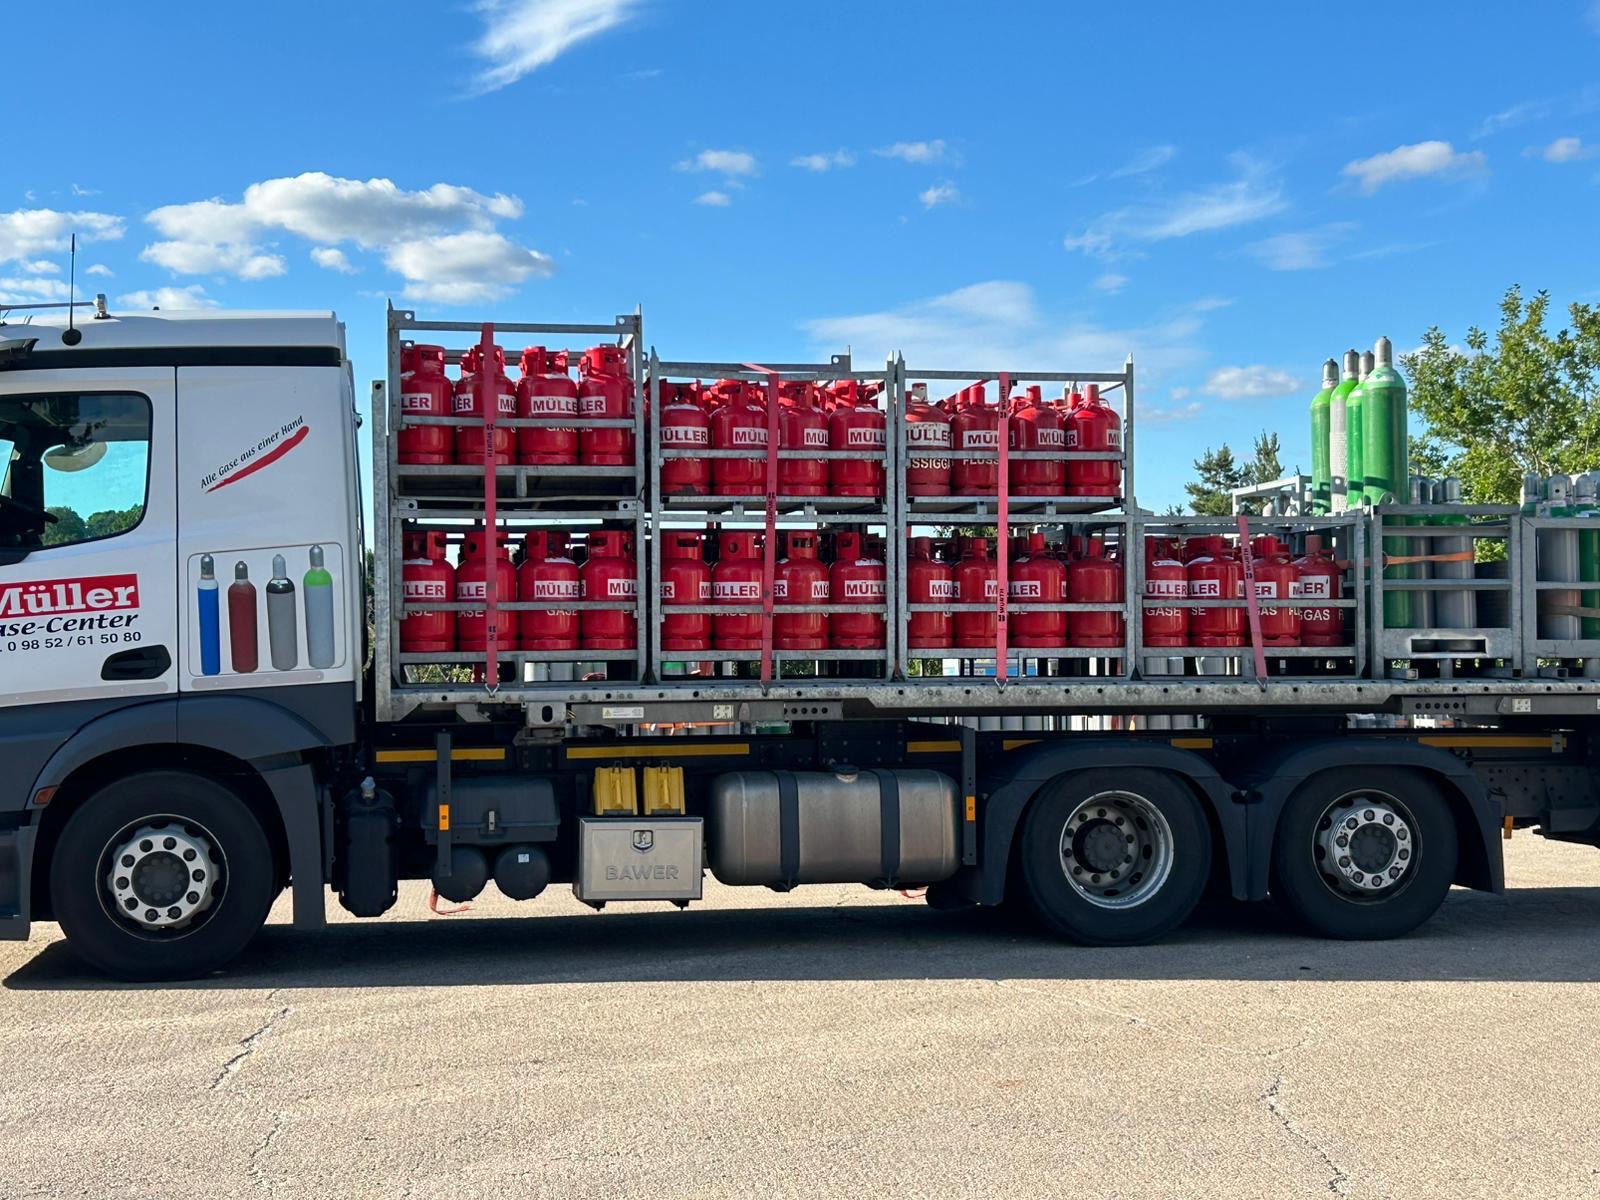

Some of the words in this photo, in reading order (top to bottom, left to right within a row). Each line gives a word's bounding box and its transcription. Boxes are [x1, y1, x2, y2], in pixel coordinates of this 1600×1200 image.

[201, 472, 217, 489] Alle
[218, 458, 239, 476] Gase
[240, 447, 256, 462] aus
[257, 431, 280, 450] einer
[281, 415, 304, 436] Hand
[8, 641, 17, 652] 0
[21, 639, 40, 650] 98
[45, 637, 64, 648] 52
[77, 634, 94, 646] 61
[101, 632, 119, 644] 50
[123, 630, 142, 642] 80
[606, 864, 679, 881] BAWER
